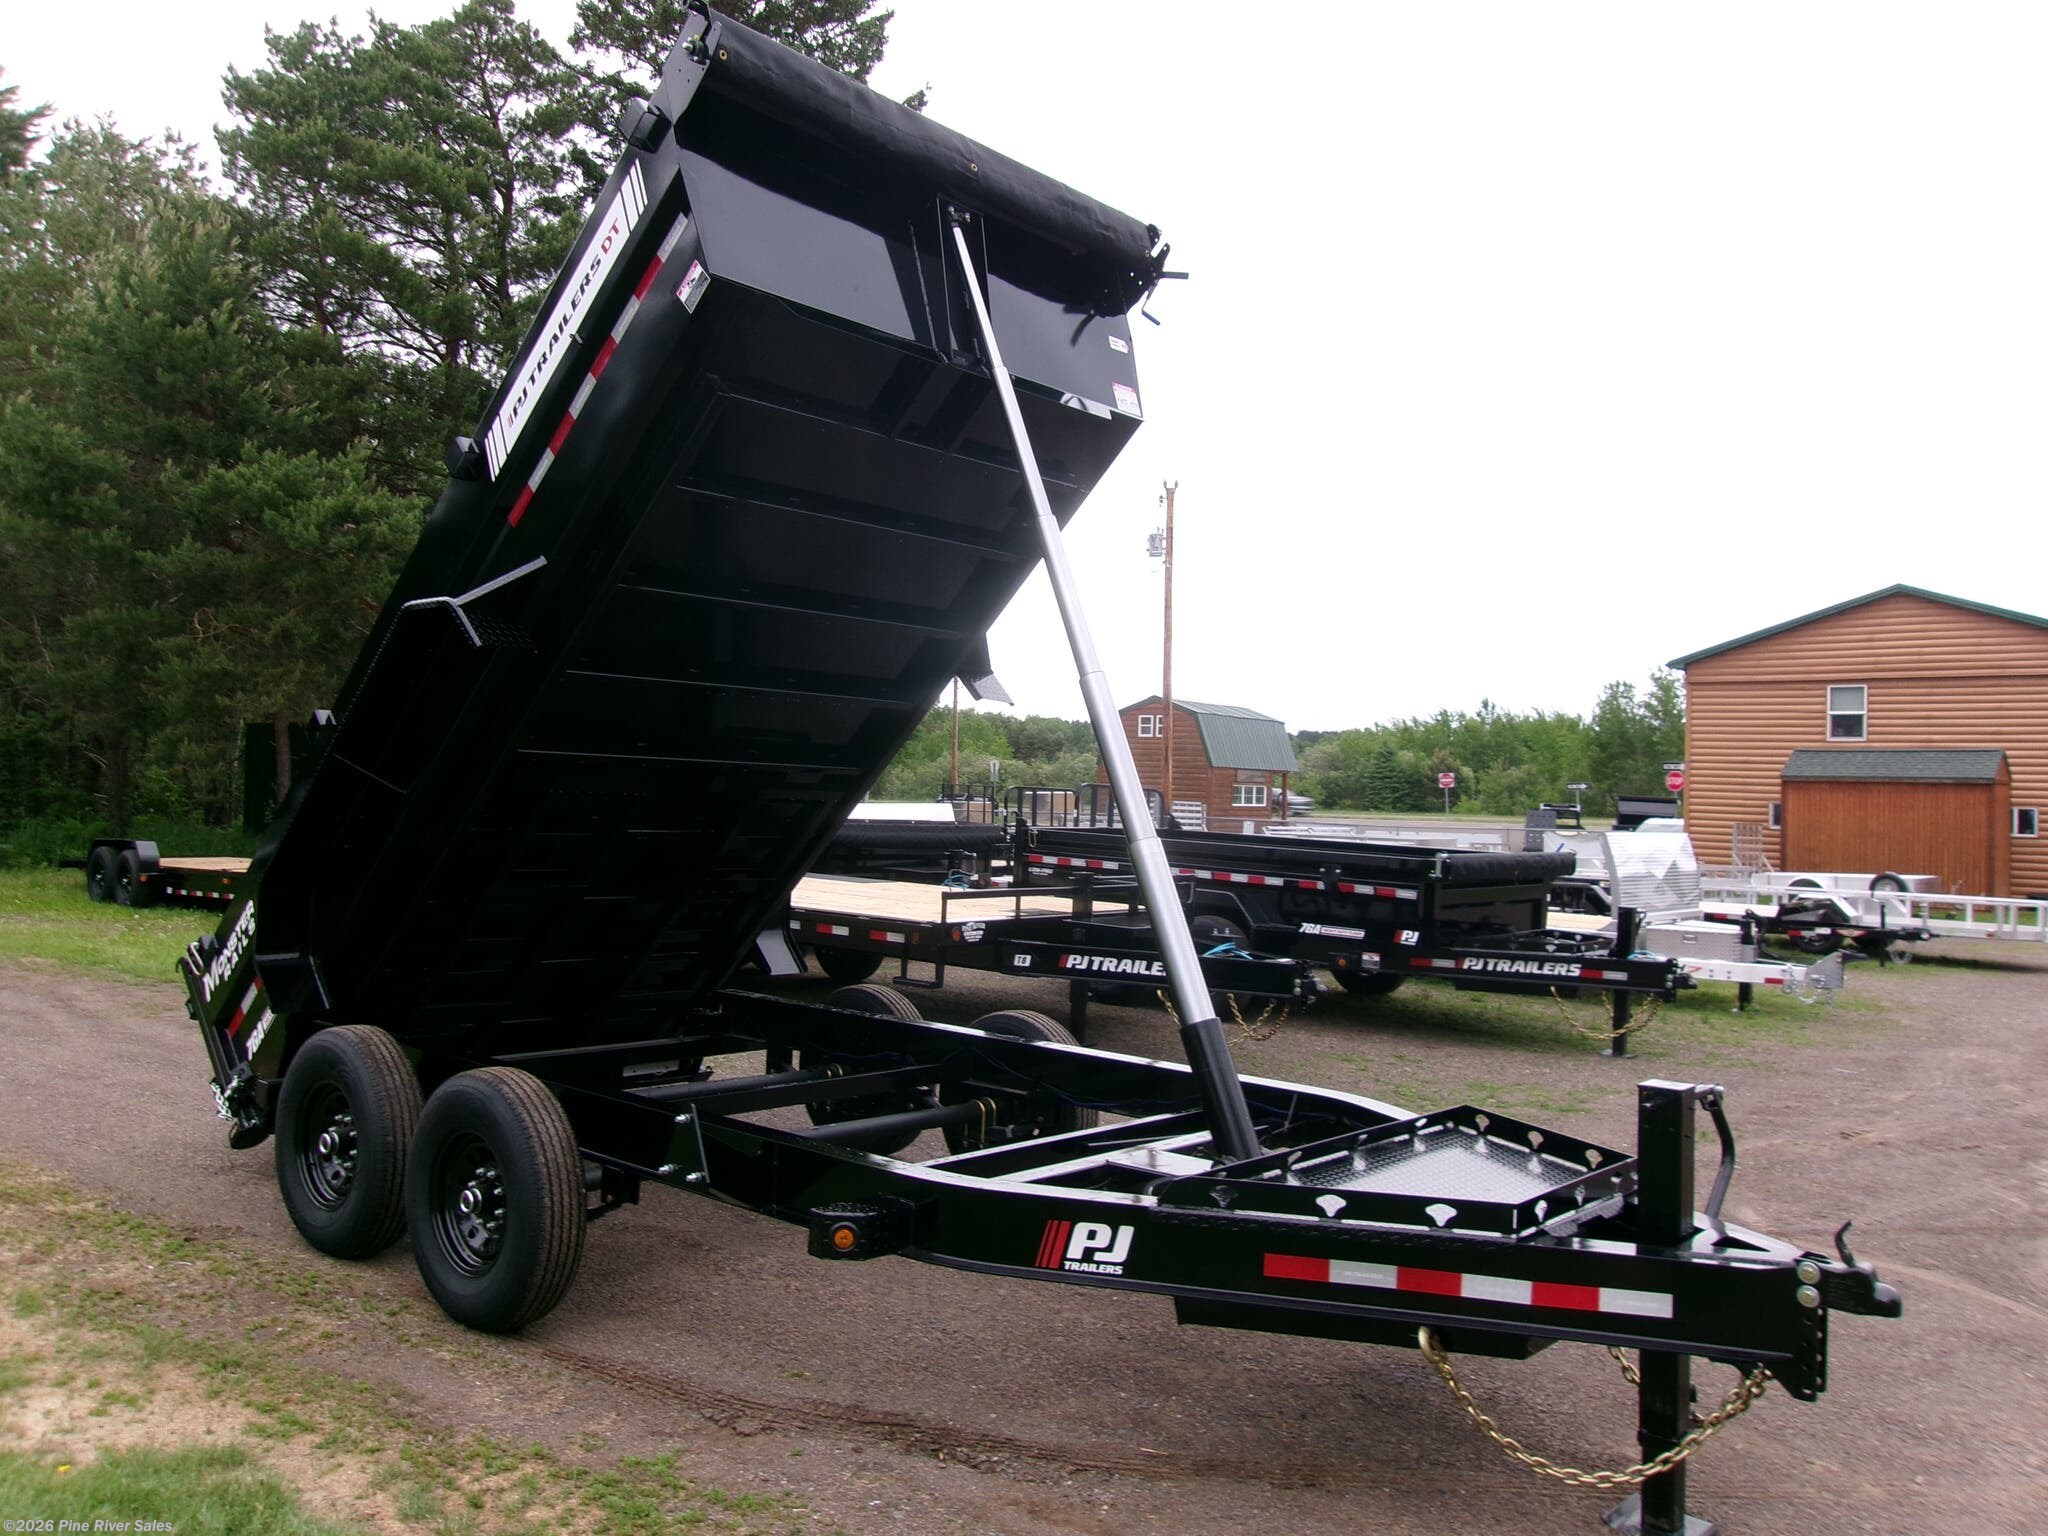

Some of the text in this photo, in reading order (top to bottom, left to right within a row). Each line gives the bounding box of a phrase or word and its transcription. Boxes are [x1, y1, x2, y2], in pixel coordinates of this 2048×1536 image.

[600, 217, 622, 256] DT
[224, 916, 256, 982] RAILS
[1400, 929, 1420, 943] PJ
[1090, 955, 1167, 977] TRAILE
[1065, 1221, 1135, 1263] PJ
[1063, 1260, 1124, 1275] TRAILERS
